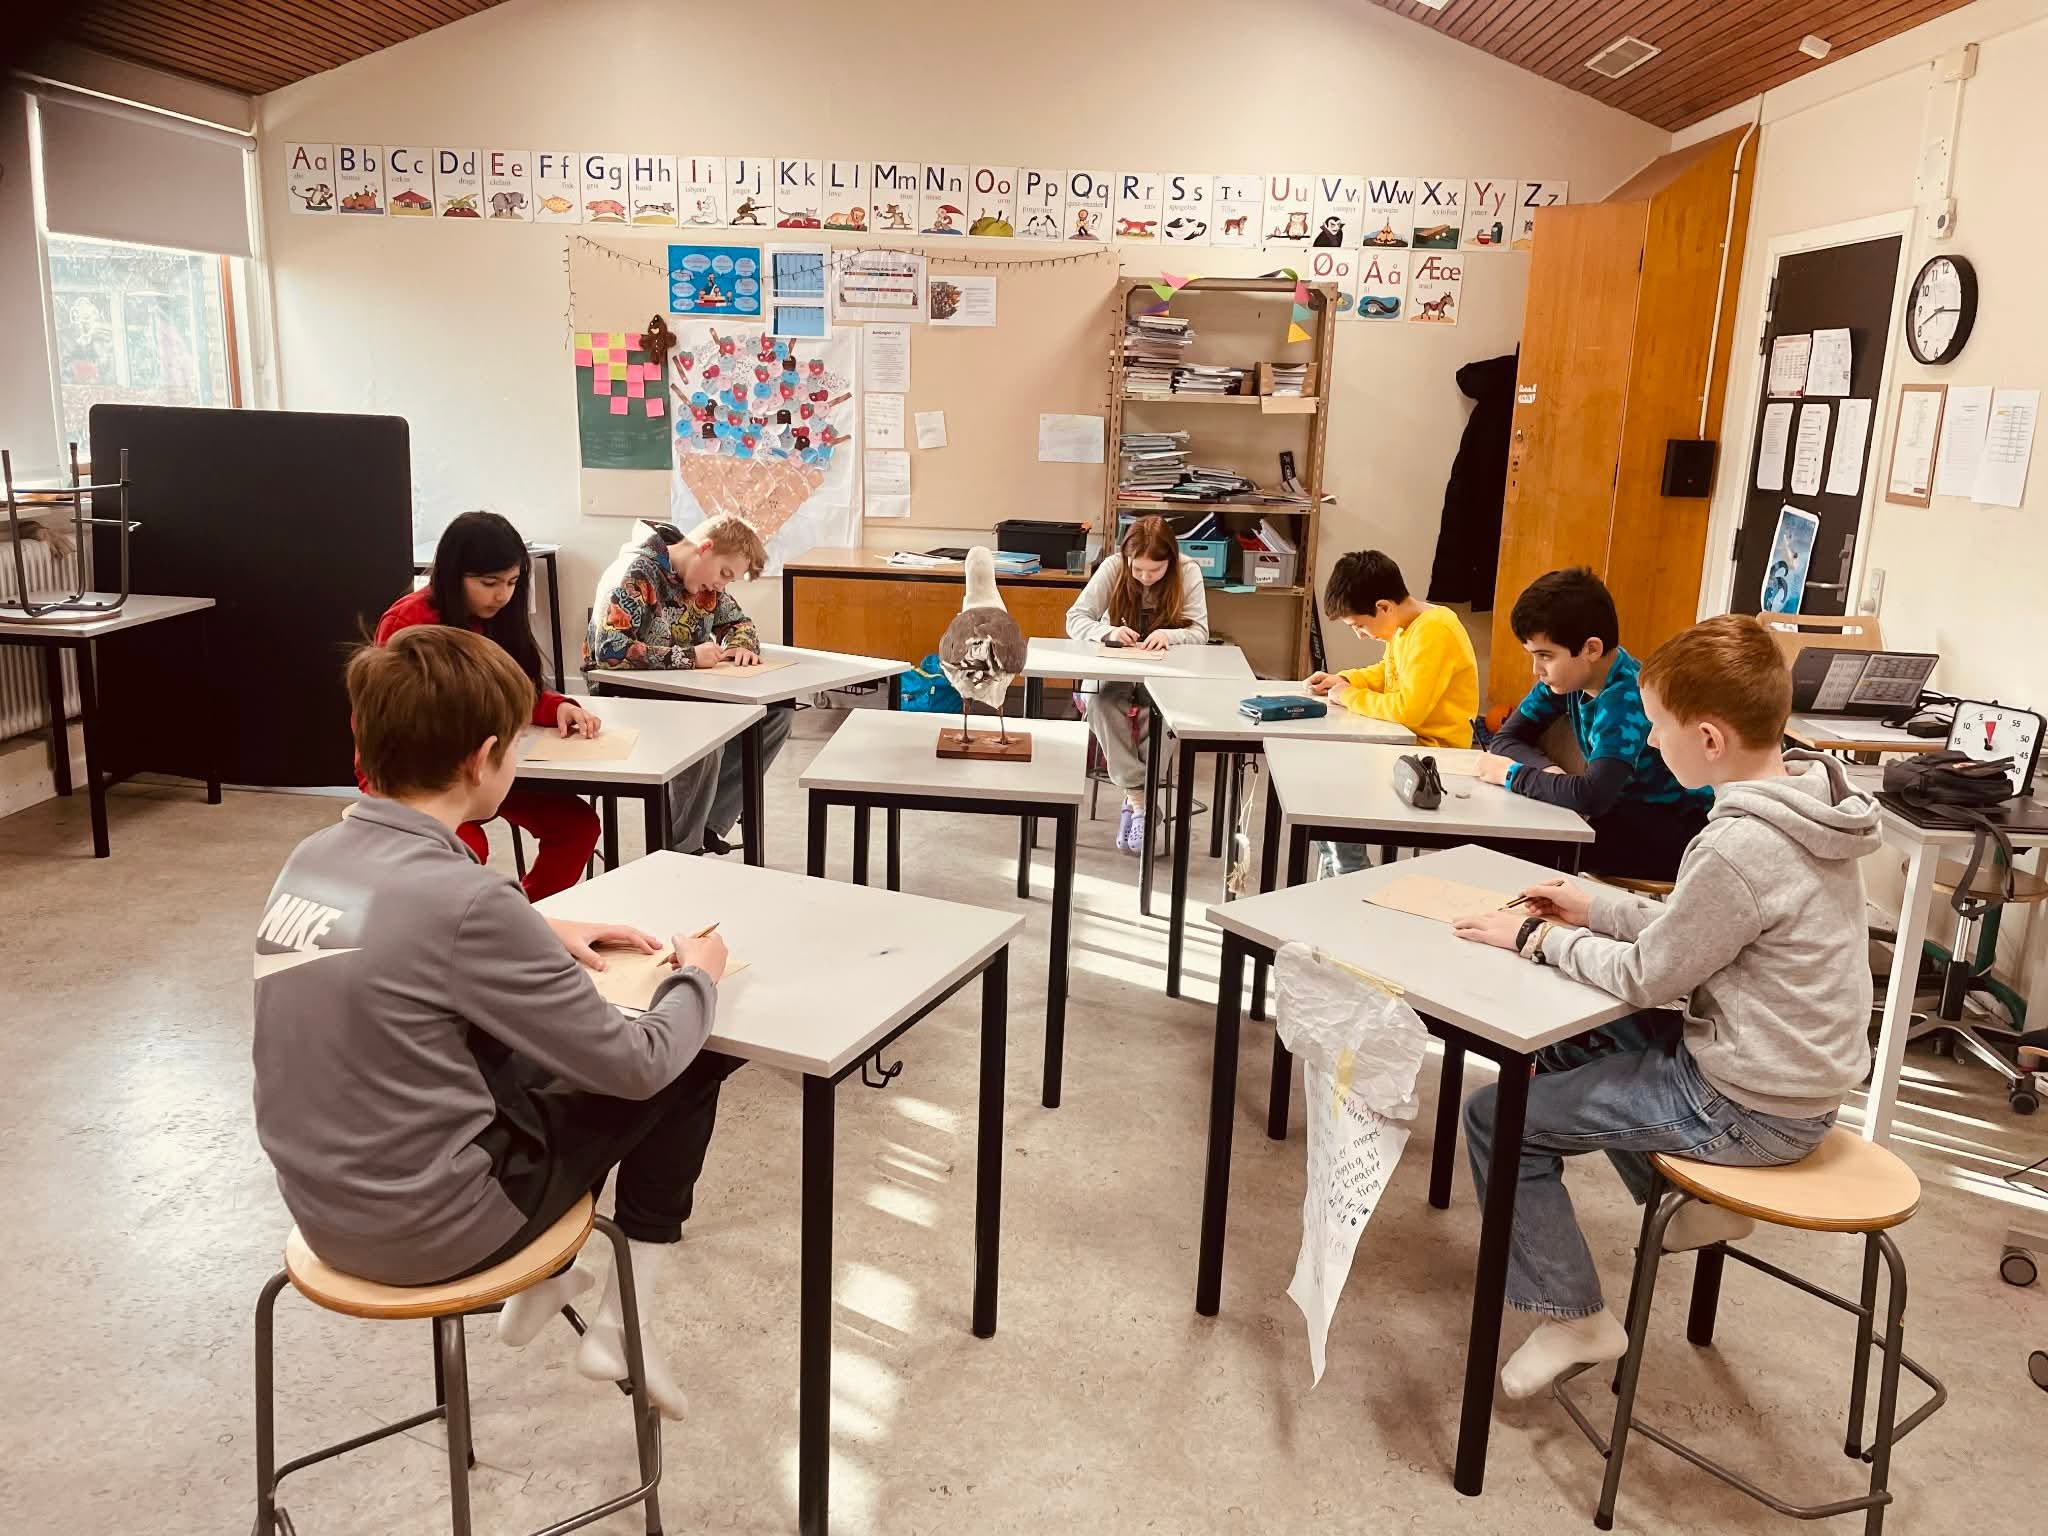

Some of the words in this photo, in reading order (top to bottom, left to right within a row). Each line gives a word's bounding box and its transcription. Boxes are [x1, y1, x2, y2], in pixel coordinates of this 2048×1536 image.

[292, 146, 327, 170] Aa
[340, 147, 376, 172] Bb
[391, 149, 424, 173] Cc
[440, 150, 475, 175] Dd
[491, 152, 523, 177] Ee
[540, 155, 569, 178] Ff
[635, 157, 671, 182] Hh
[585, 155, 622, 190] Gg
[735, 160, 761, 195] Jj
[780, 161, 816, 186] Kk
[875, 164, 917, 190] Mm
[926, 166, 962, 193] Nn
[975, 168, 1011, 195] Oo
[1027, 172, 1058, 206] Pp
[1071, 172, 1109, 209] Qq
[1123, 175, 1155, 200] Rr
[1171, 176, 1203, 201] Ss
[1271, 176, 1308, 202] Uu
[1368, 180, 1414, 204] Ww
[1421, 181, 1458, 206] Xx
[1474, 182, 1506, 216] Yy
[1363, 254, 1401, 284] Åå
[1931, 269, 1938, 281] 11
[1942, 261, 1950, 274] 12
[1922, 284, 1930, 297] 10
[1923, 340, 1929, 353] 7
[1963, 722, 1971, 731] 10
[2012, 719, 2021, 728] 55
[1953, 737, 1961, 745] 15
[2020, 734, 2030, 743] 50
[2019, 751, 2029, 760] 45
[257, 892, 344, 951] NIKE
